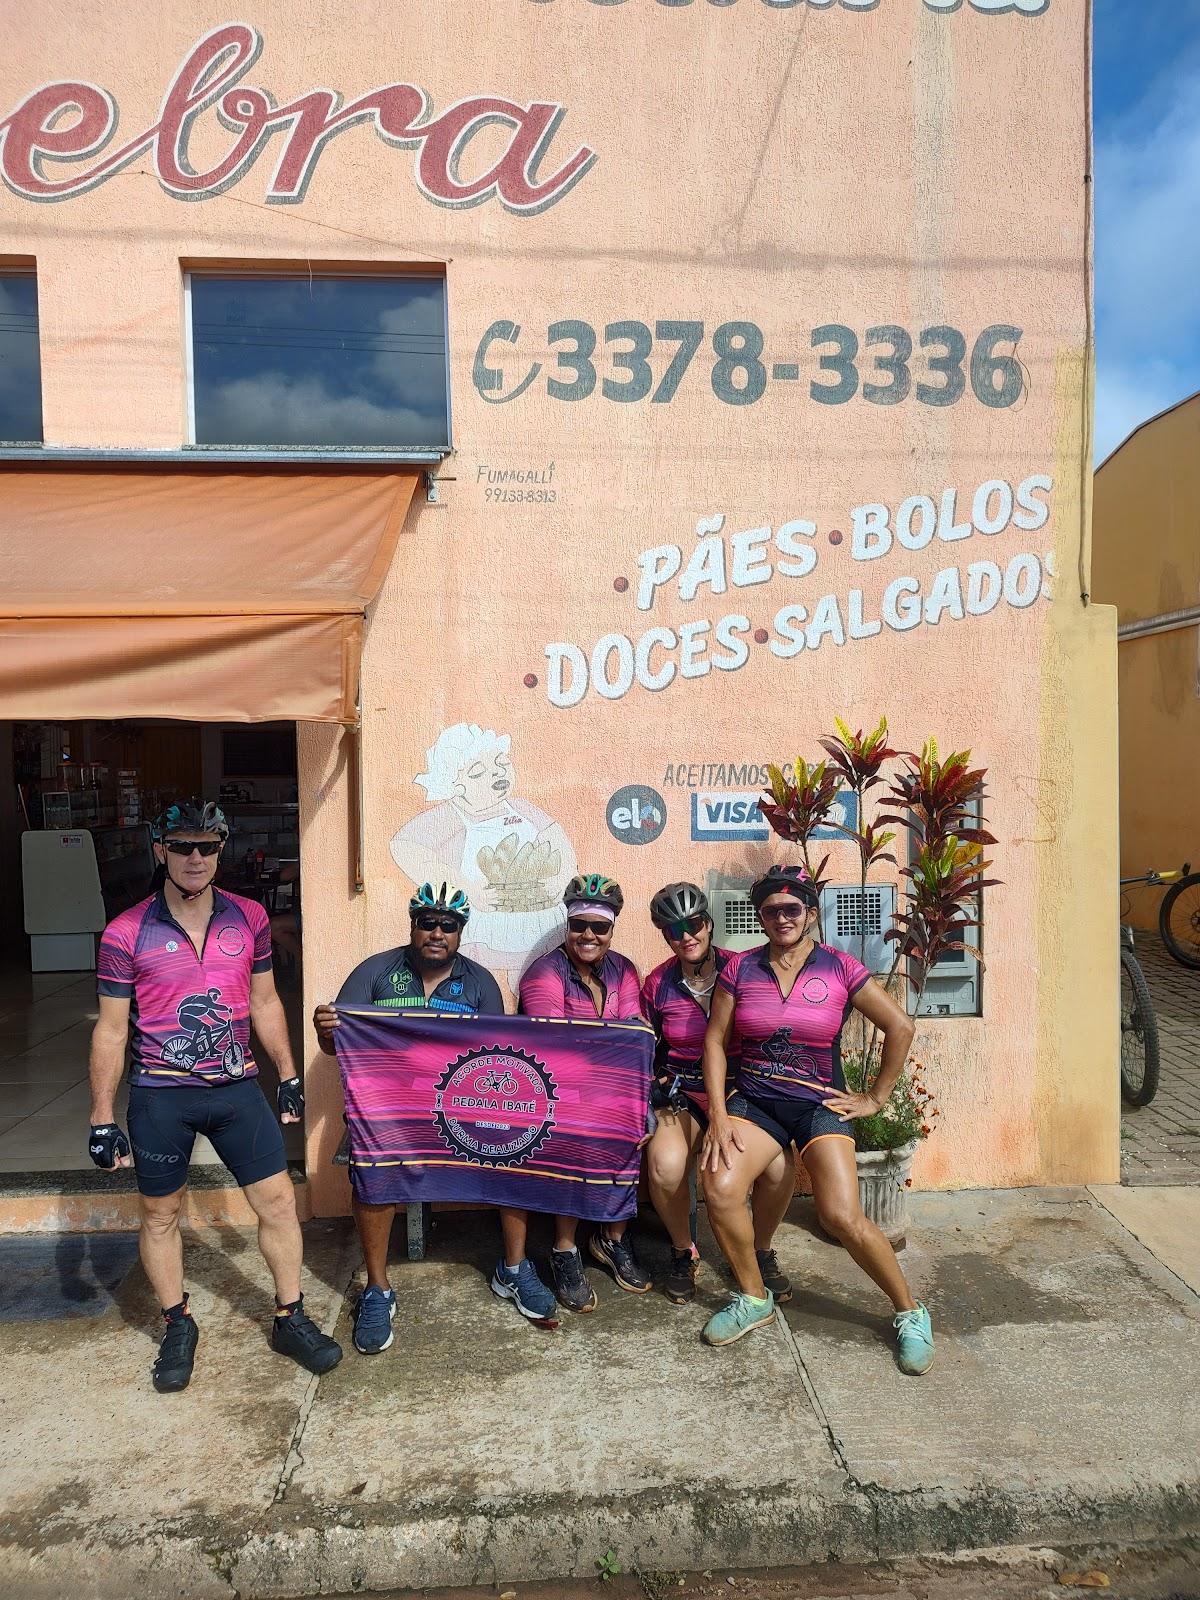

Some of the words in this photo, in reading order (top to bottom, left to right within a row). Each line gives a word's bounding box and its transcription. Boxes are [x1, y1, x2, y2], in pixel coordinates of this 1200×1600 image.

[547, 319, 1024, 408] 3378-3336
[636, 513, 818, 612] PÃES
[849, 474, 1054, 563] BOLOS
[544, 614, 751, 709] DOCES
[662, 763, 769, 788] ACEITAMOS
[611, 798, 662, 830] elo
[705, 801, 764, 824] VISA
[453, 1057, 493, 1087] ACORDE
[495, 1056, 544, 1094] MOTIVADO
[452, 1096, 498, 1109] PEDALA
[502, 1099, 536, 1113] IBATÉ
[448, 1118, 480, 1150] DURMA
[480, 1125, 538, 1156] REALIZADO
